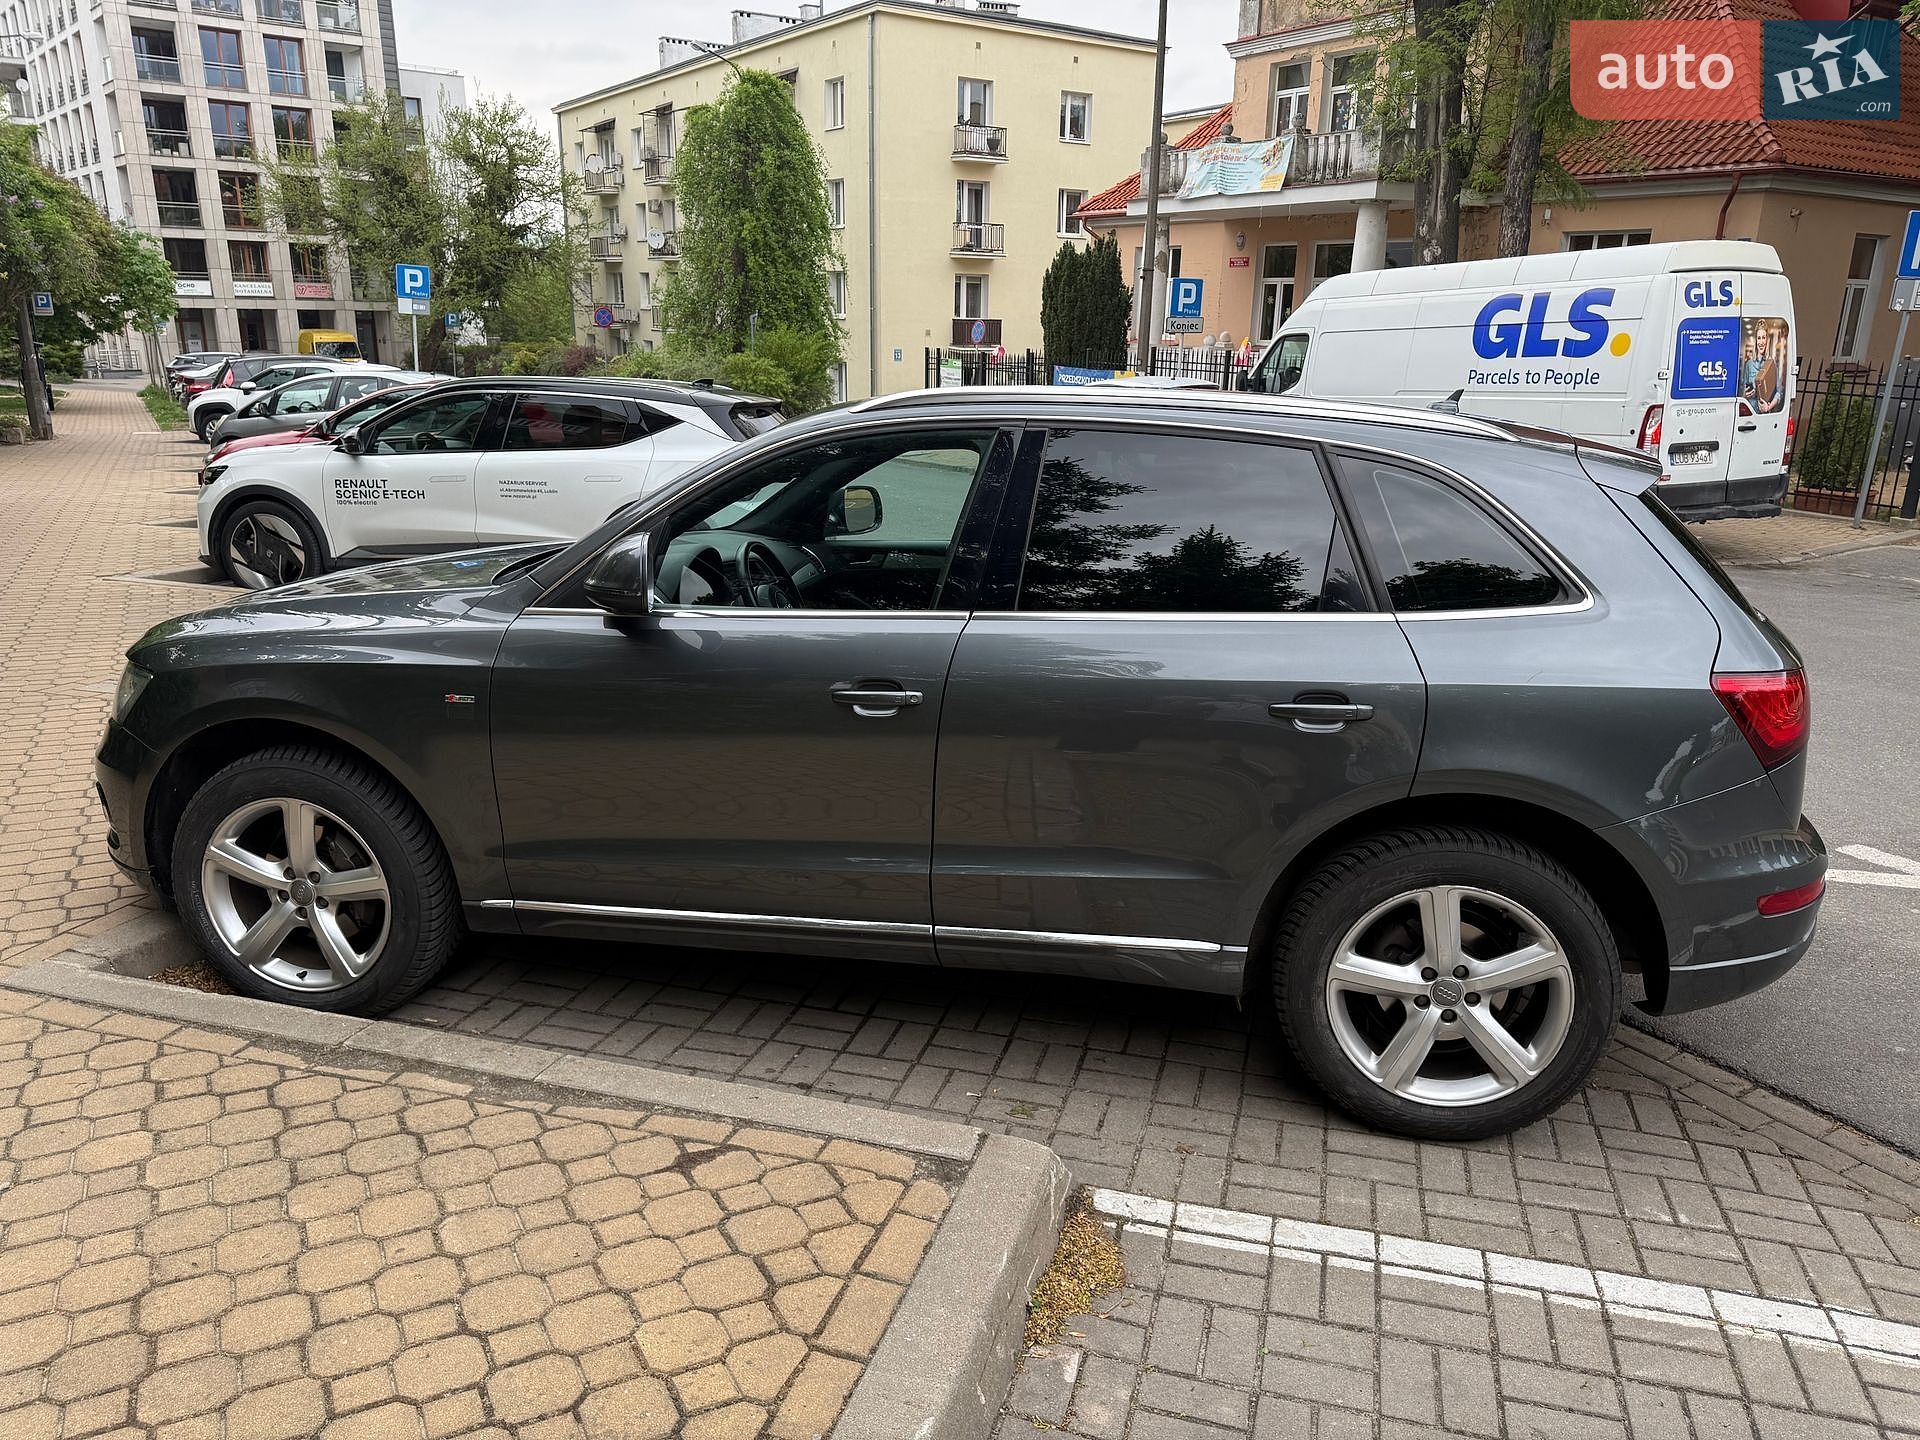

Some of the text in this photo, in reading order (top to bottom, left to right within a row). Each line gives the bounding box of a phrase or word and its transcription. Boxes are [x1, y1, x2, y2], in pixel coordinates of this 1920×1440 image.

[404, 268, 423, 294] P
[1177, 282, 1197, 312] P
[1170, 320, 1199, 330] Koniec
[1467, 367, 1600, 390] Parcels to People
[1676, 407, 1717, 417] gls-group.com
[334, 479, 388, 489] RENAULT
[335, 489, 426, 500] SCENIC E-TECH
